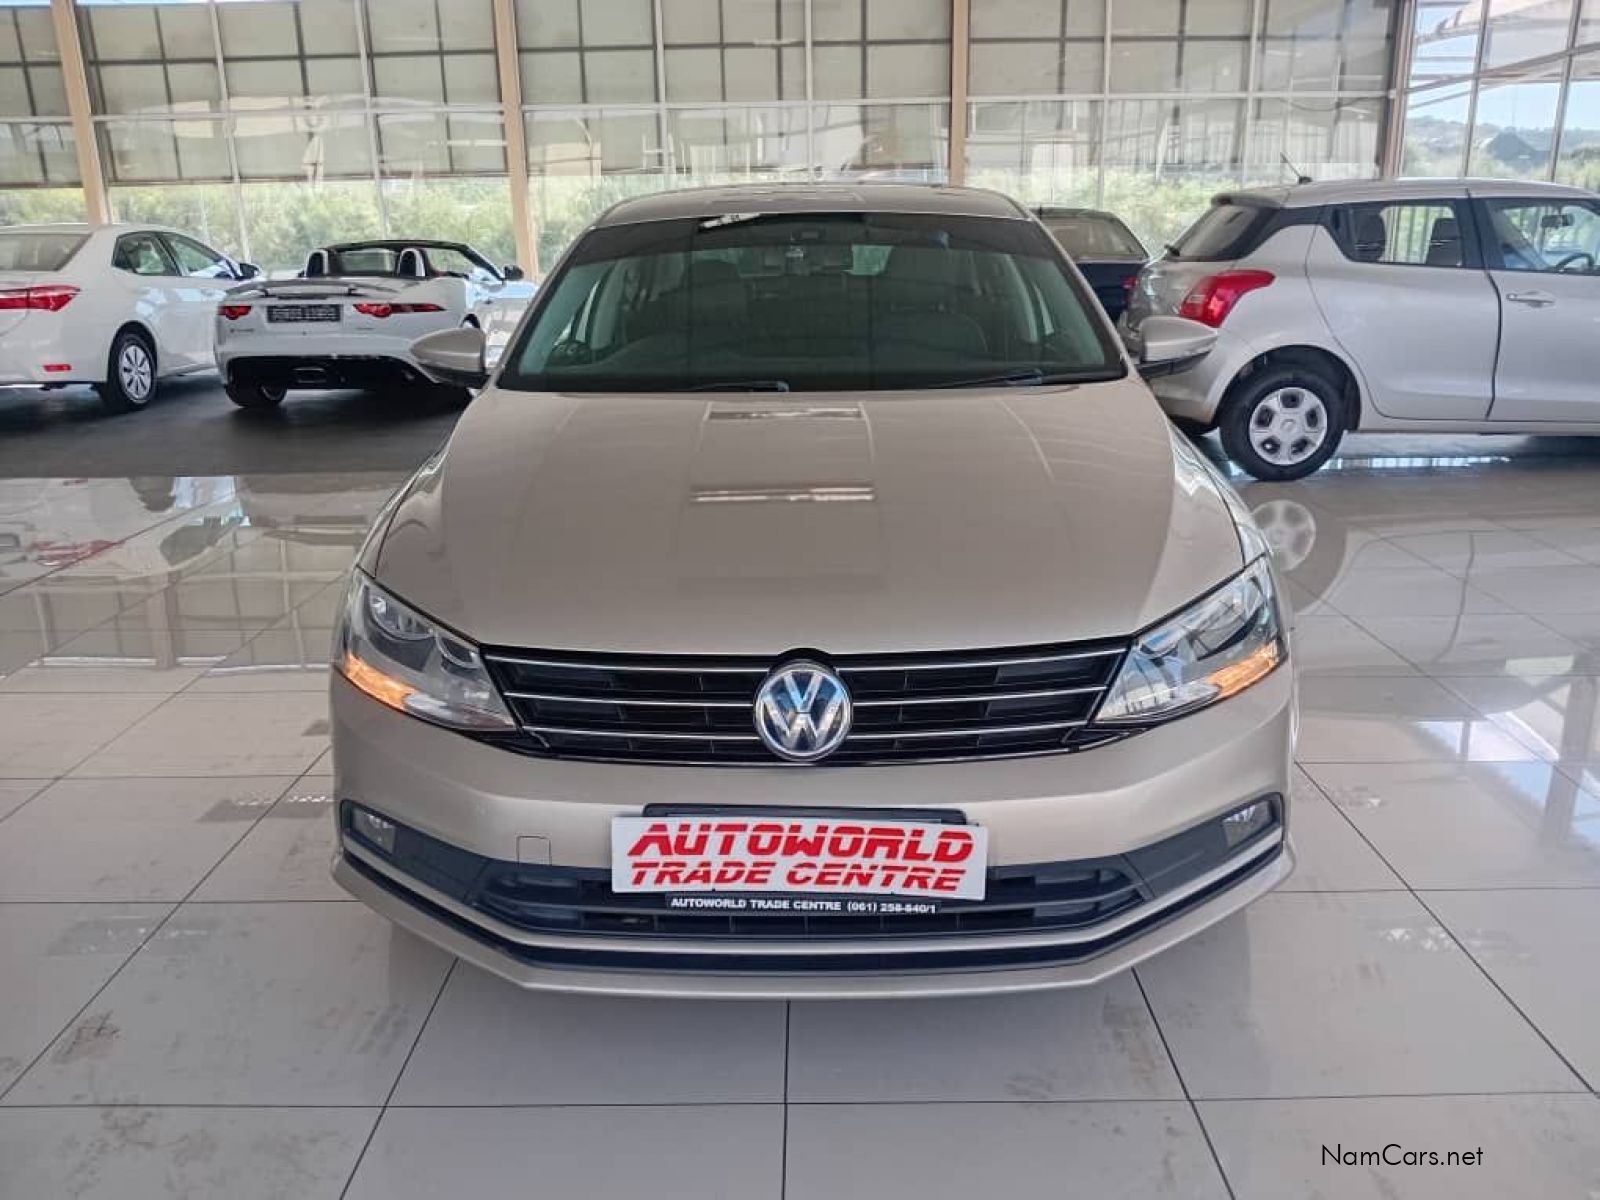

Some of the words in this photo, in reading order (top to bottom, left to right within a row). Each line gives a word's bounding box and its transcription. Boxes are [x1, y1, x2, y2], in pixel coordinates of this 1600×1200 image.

[758, 665, 848, 757] VW
[628, 823, 974, 862] AUTOWORLD
[631, 862, 777, 887] TRADE
[786, 863, 966, 892] CENTRE
[670, 898, 746, 908] AUTOWORLD
[750, 899, 790, 909] TRADE
[793, 900, 842, 911] CENTRE
[847, 901, 878, 912] (061)
